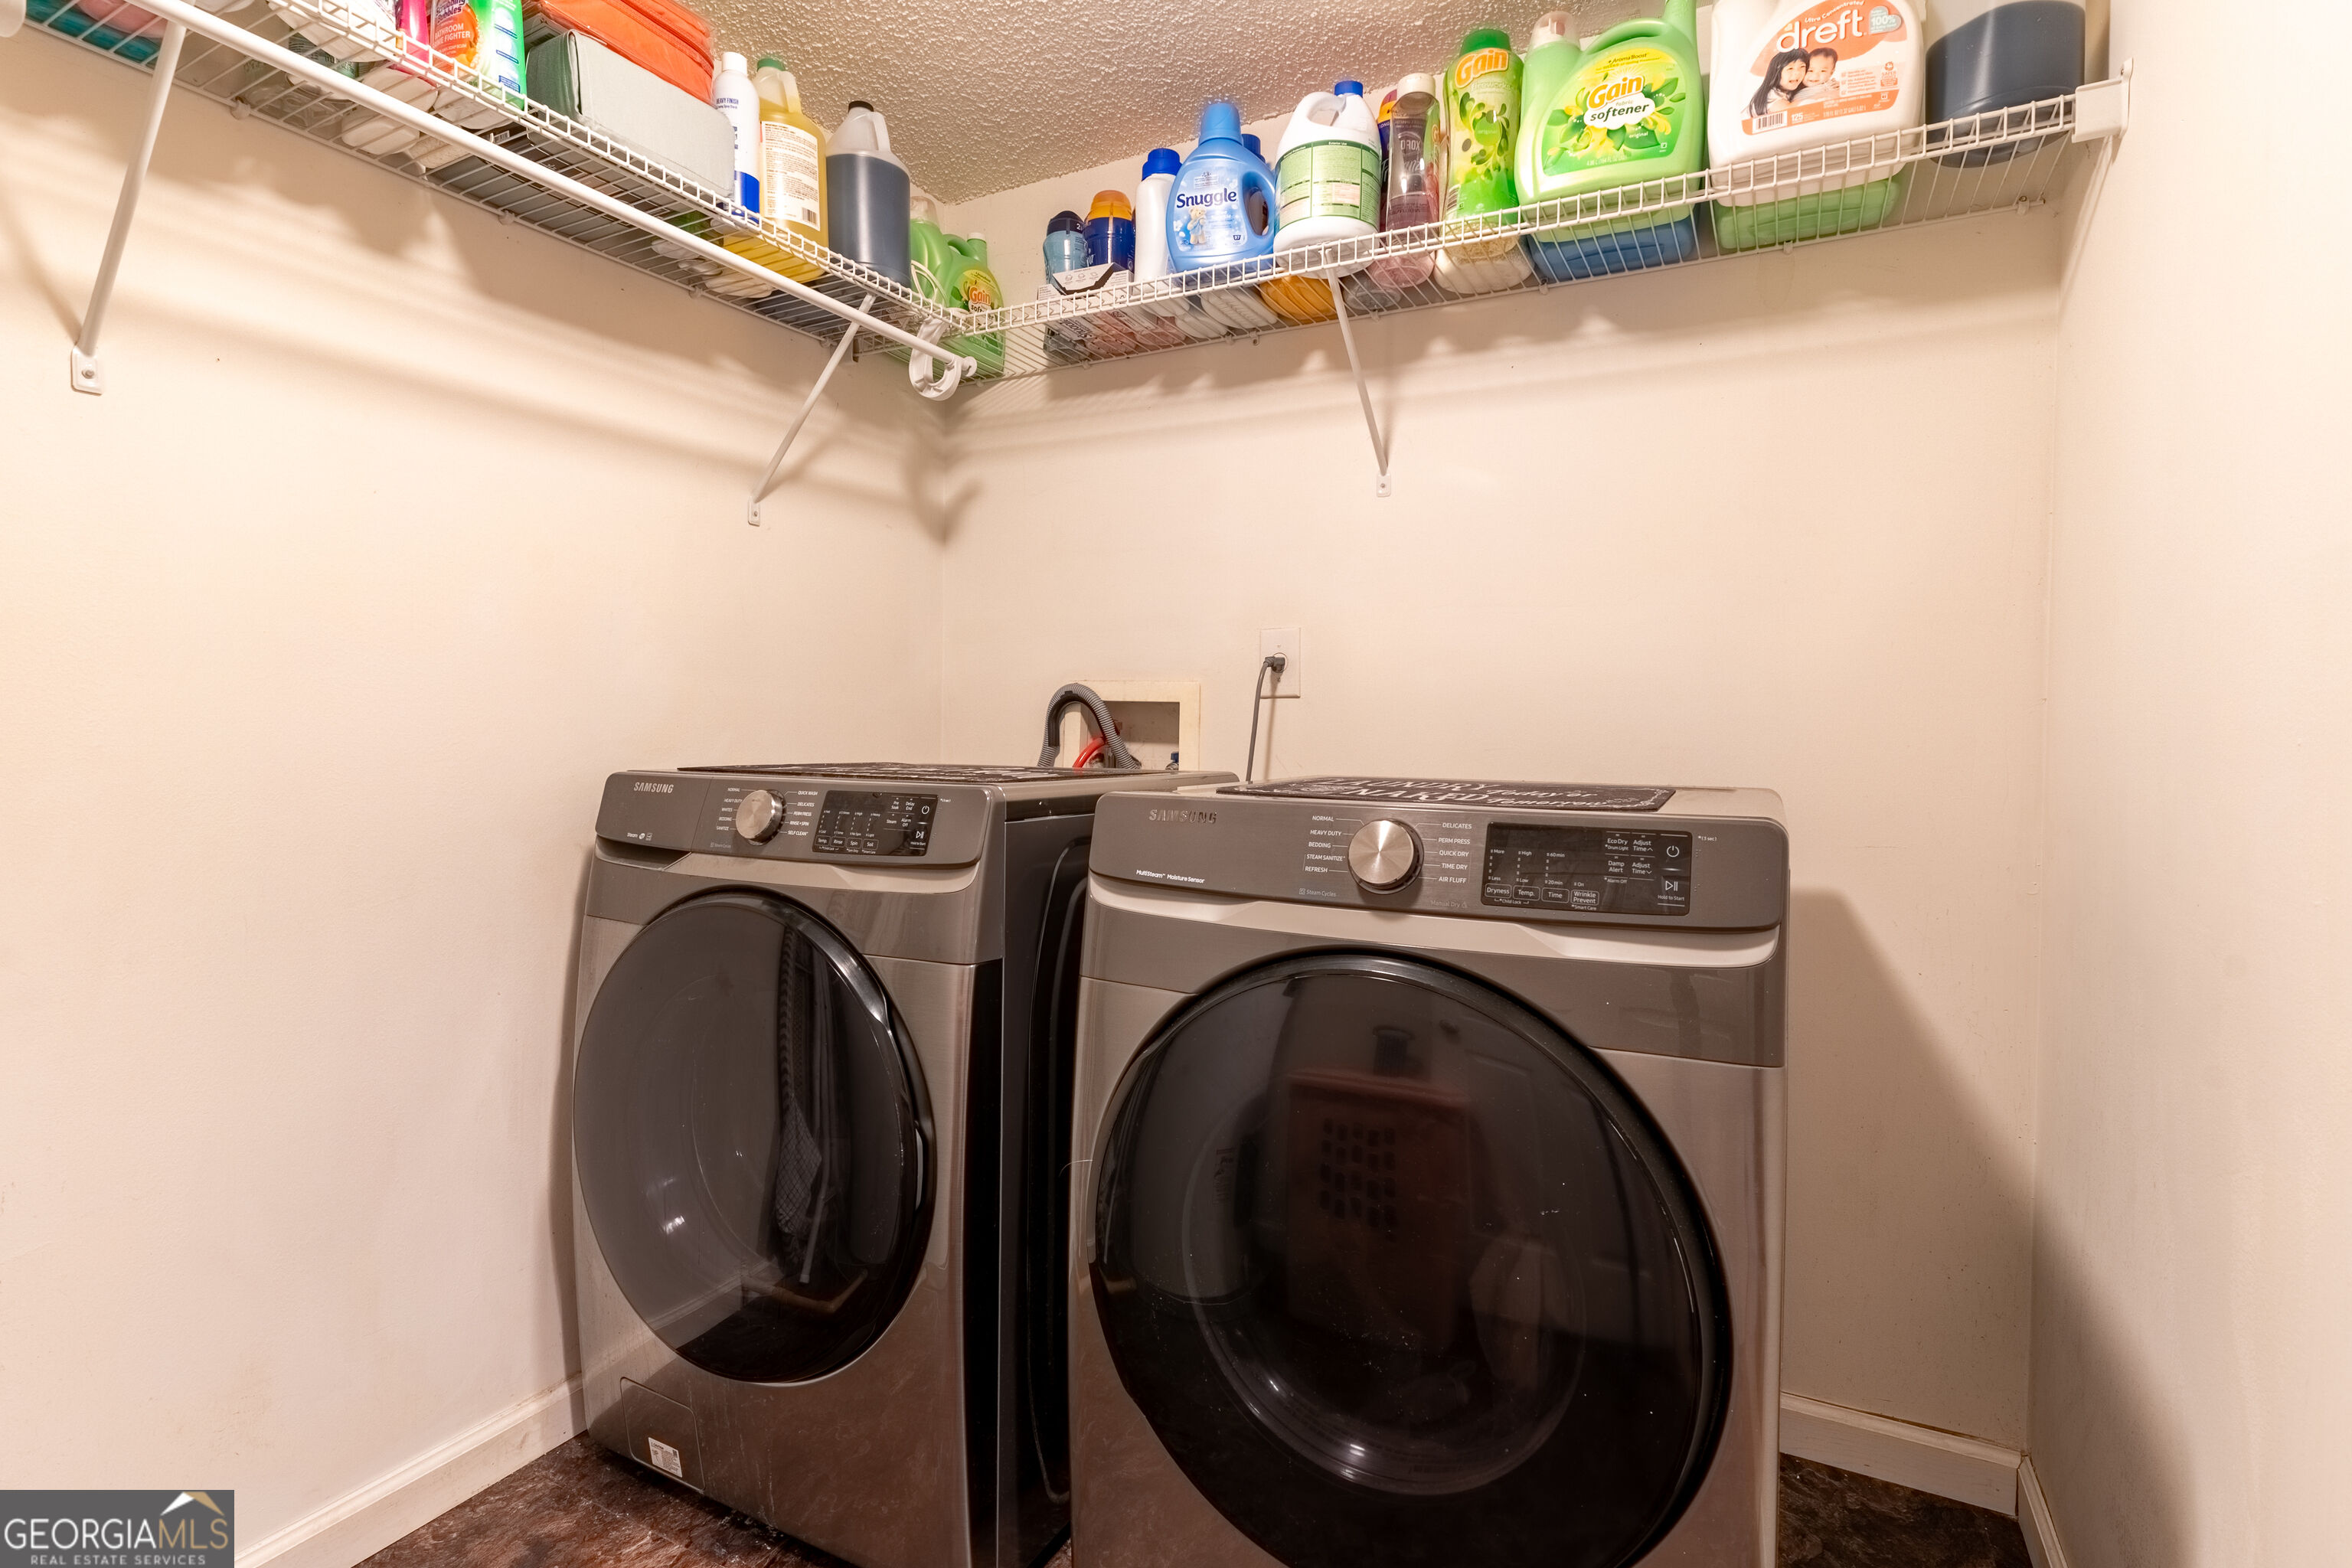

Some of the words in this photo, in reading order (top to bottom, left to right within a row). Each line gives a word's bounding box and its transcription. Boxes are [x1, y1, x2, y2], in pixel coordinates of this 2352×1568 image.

[1805, 15, 1821, 24] Ultra
[1821, 0, 1864, 20] Concentrated
[1871, 15, 1896, 26] 100%
[435, 23, 464, 39] BATHROOM
[444, 31, 471, 42] FIGHTER
[1776, 9, 1863, 53] dreft
[1455, 47, 1509, 88] Gain
[1588, 77, 1643, 109] Gain
[1589, 104, 1650, 122] softener
[1792, 112, 1804, 122] 125
[1176, 188, 1237, 208] Snuggle
[969, 287, 991, 305] Gain
[633, 782, 675, 794] SAMSUNG
[1340, 788, 1490, 802] NAKED
[1148, 809, 1217, 825] SAMSUNG
[1486, 887, 1510, 895] Dryness
[1518, 889, 1535, 897] Temp.
